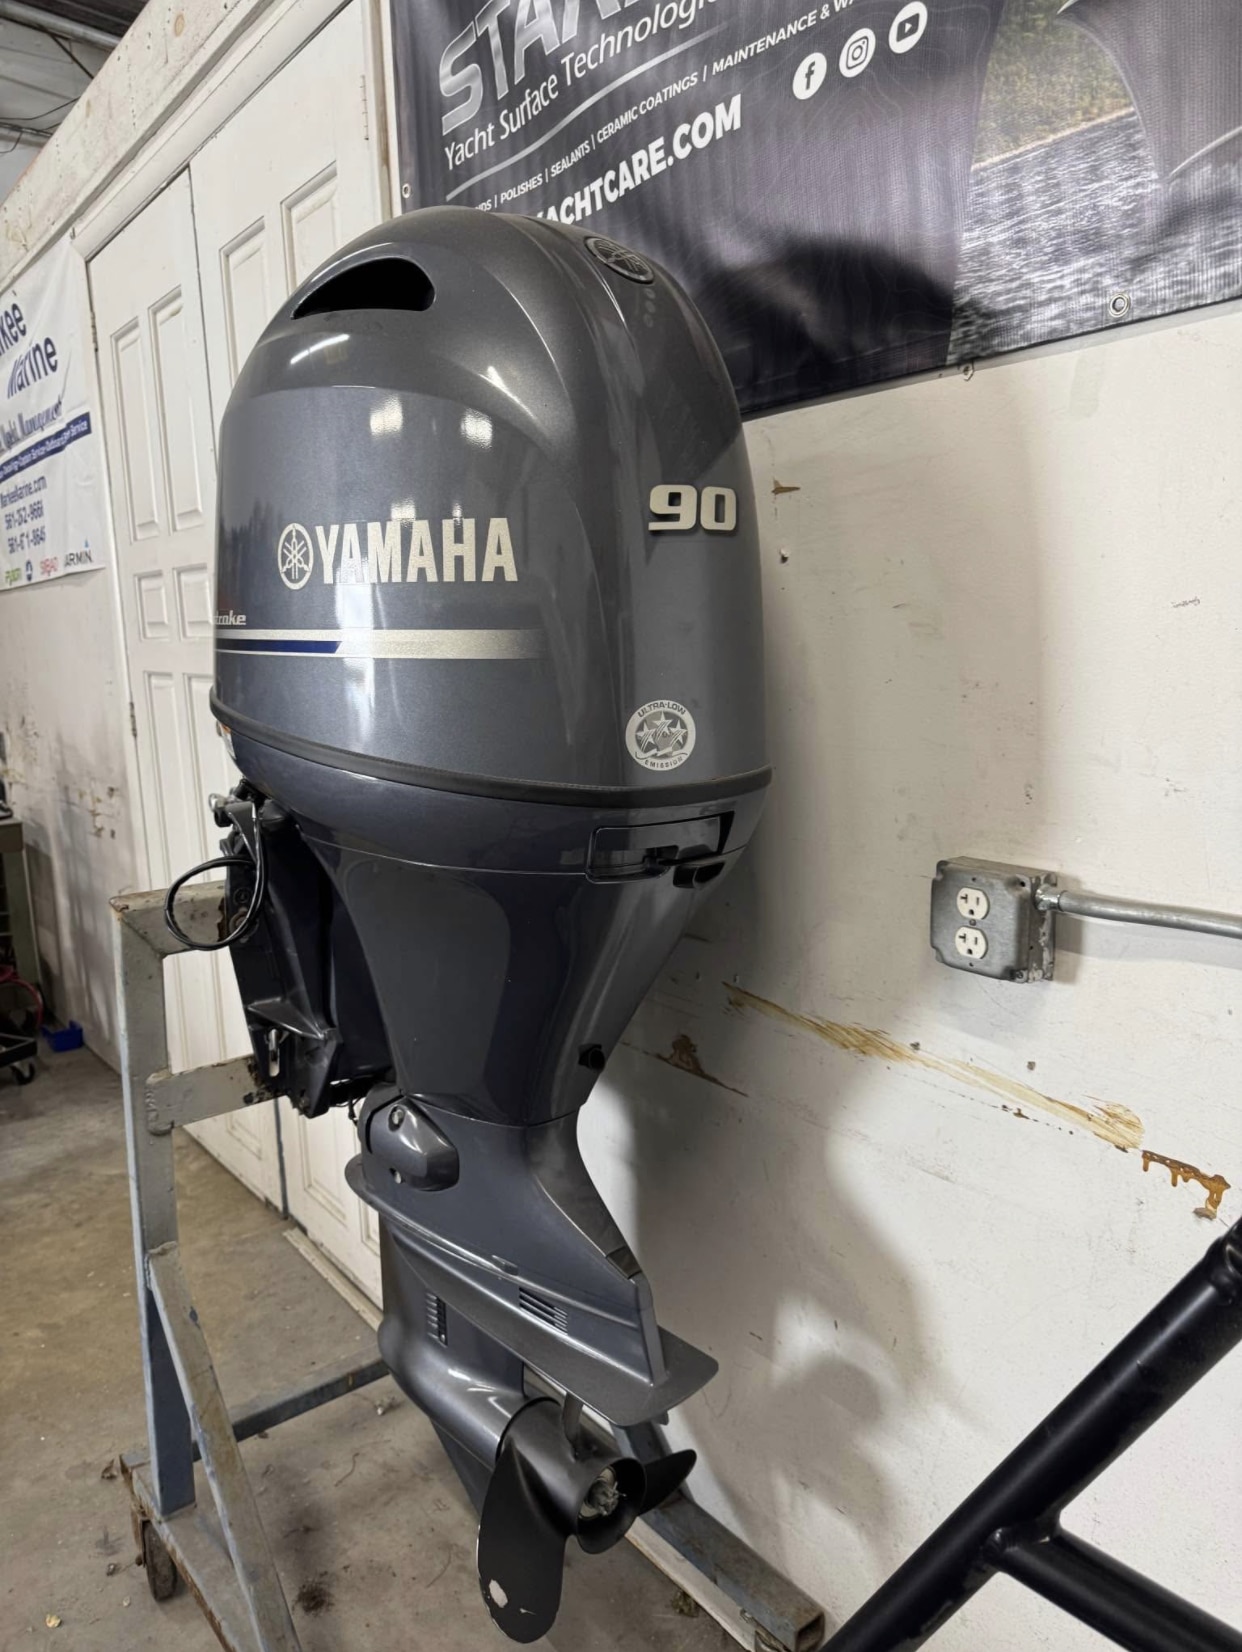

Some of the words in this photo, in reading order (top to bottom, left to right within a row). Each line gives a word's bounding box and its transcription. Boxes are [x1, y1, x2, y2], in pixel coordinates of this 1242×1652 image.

[444, 122, 495, 171] Yacht
[500, 74, 559, 139] Surface
[500, 173, 543, 204] POLISHES
[551, 140, 591, 177] SEALANTS
[597, 106, 638, 143] CERAMIC
[639, 72, 698, 114] COATINGS
[712, 10, 818, 75] MAINTENANCE
[820, 4, 830, 19] &
[537, 93, 742, 224] ACHTCARE.COM
[648, 484, 737, 531] 90
[315, 518, 518, 584] YAMAHA
[637, 701, 687, 718] ULTRA-LOW
[644, 756, 684, 769] EMISSION
